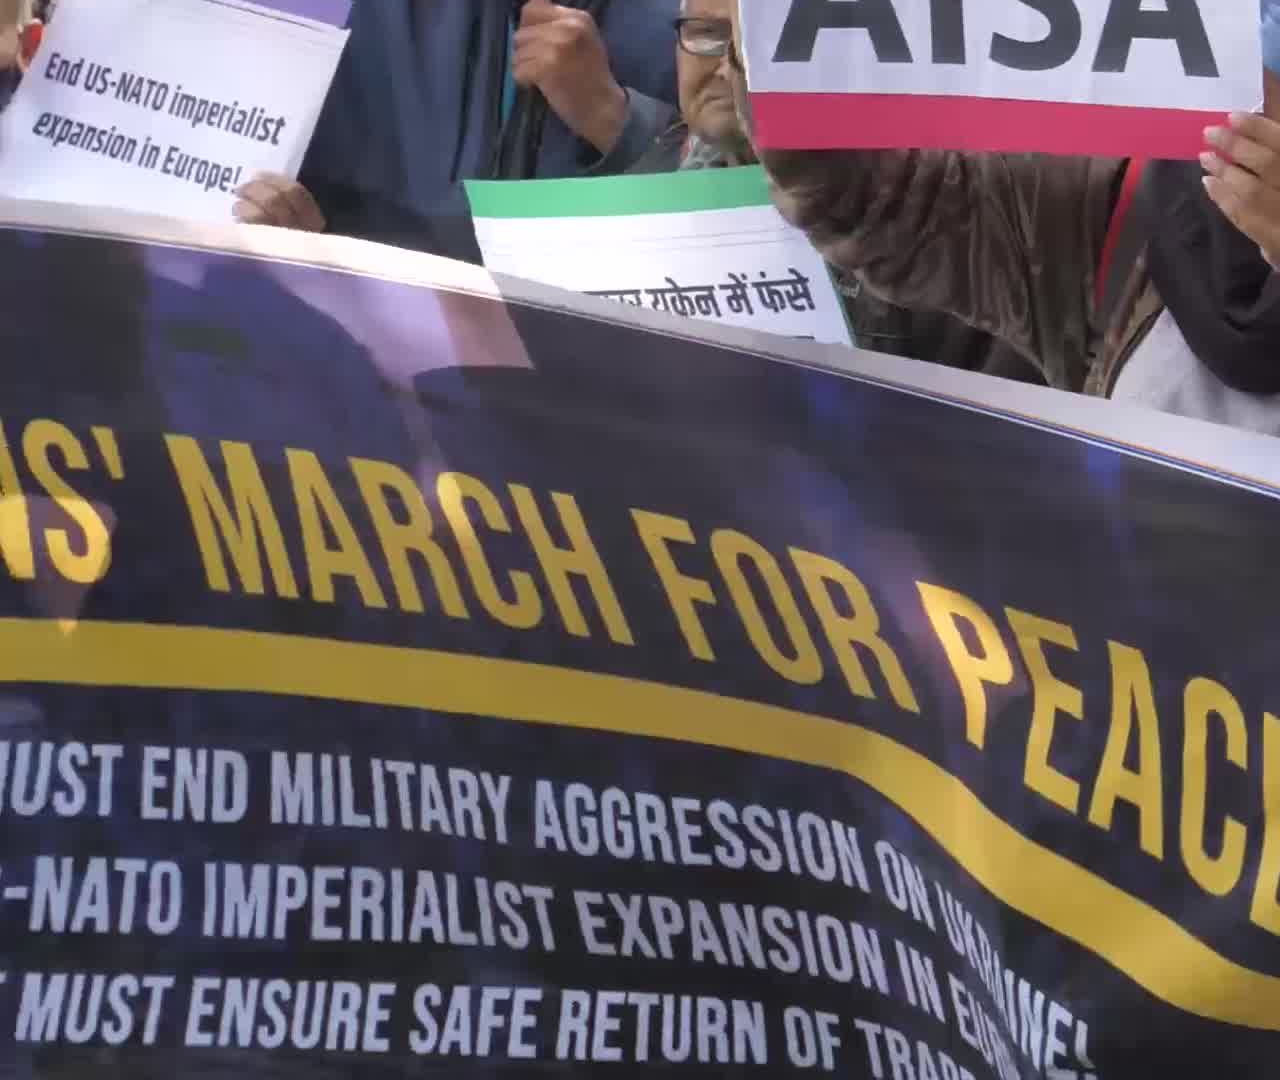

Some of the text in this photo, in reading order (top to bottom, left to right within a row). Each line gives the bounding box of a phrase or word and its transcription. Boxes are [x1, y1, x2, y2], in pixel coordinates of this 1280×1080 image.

[32, 111, 243, 194] expansion in Europe!
[44, 51, 286, 146] End US-NATO imperialist
[163, 432, 635, 647] MARCH
[630, 508, 920, 714] FOR
[141, 746, 248, 824] END
[270, 751, 511, 845] MILITARY
[533, 779, 870, 894] AGGRESSION
[874, 839, 936, 933] ON
[0, 855, 183, 936] -NATO
[203, 863, 555, 952] IMPERIALIST
[573, 891, 889, 996] EXPANSION
[896, 937, 945, 1024] IN
[14, 973, 175, 1047] MUST
[184, 977, 397, 1053] ENSURE
[409, 984, 544, 1056] SAFE
[555, 990, 768, 1064] RETURN
[783, 1007, 841, 1069] OF
